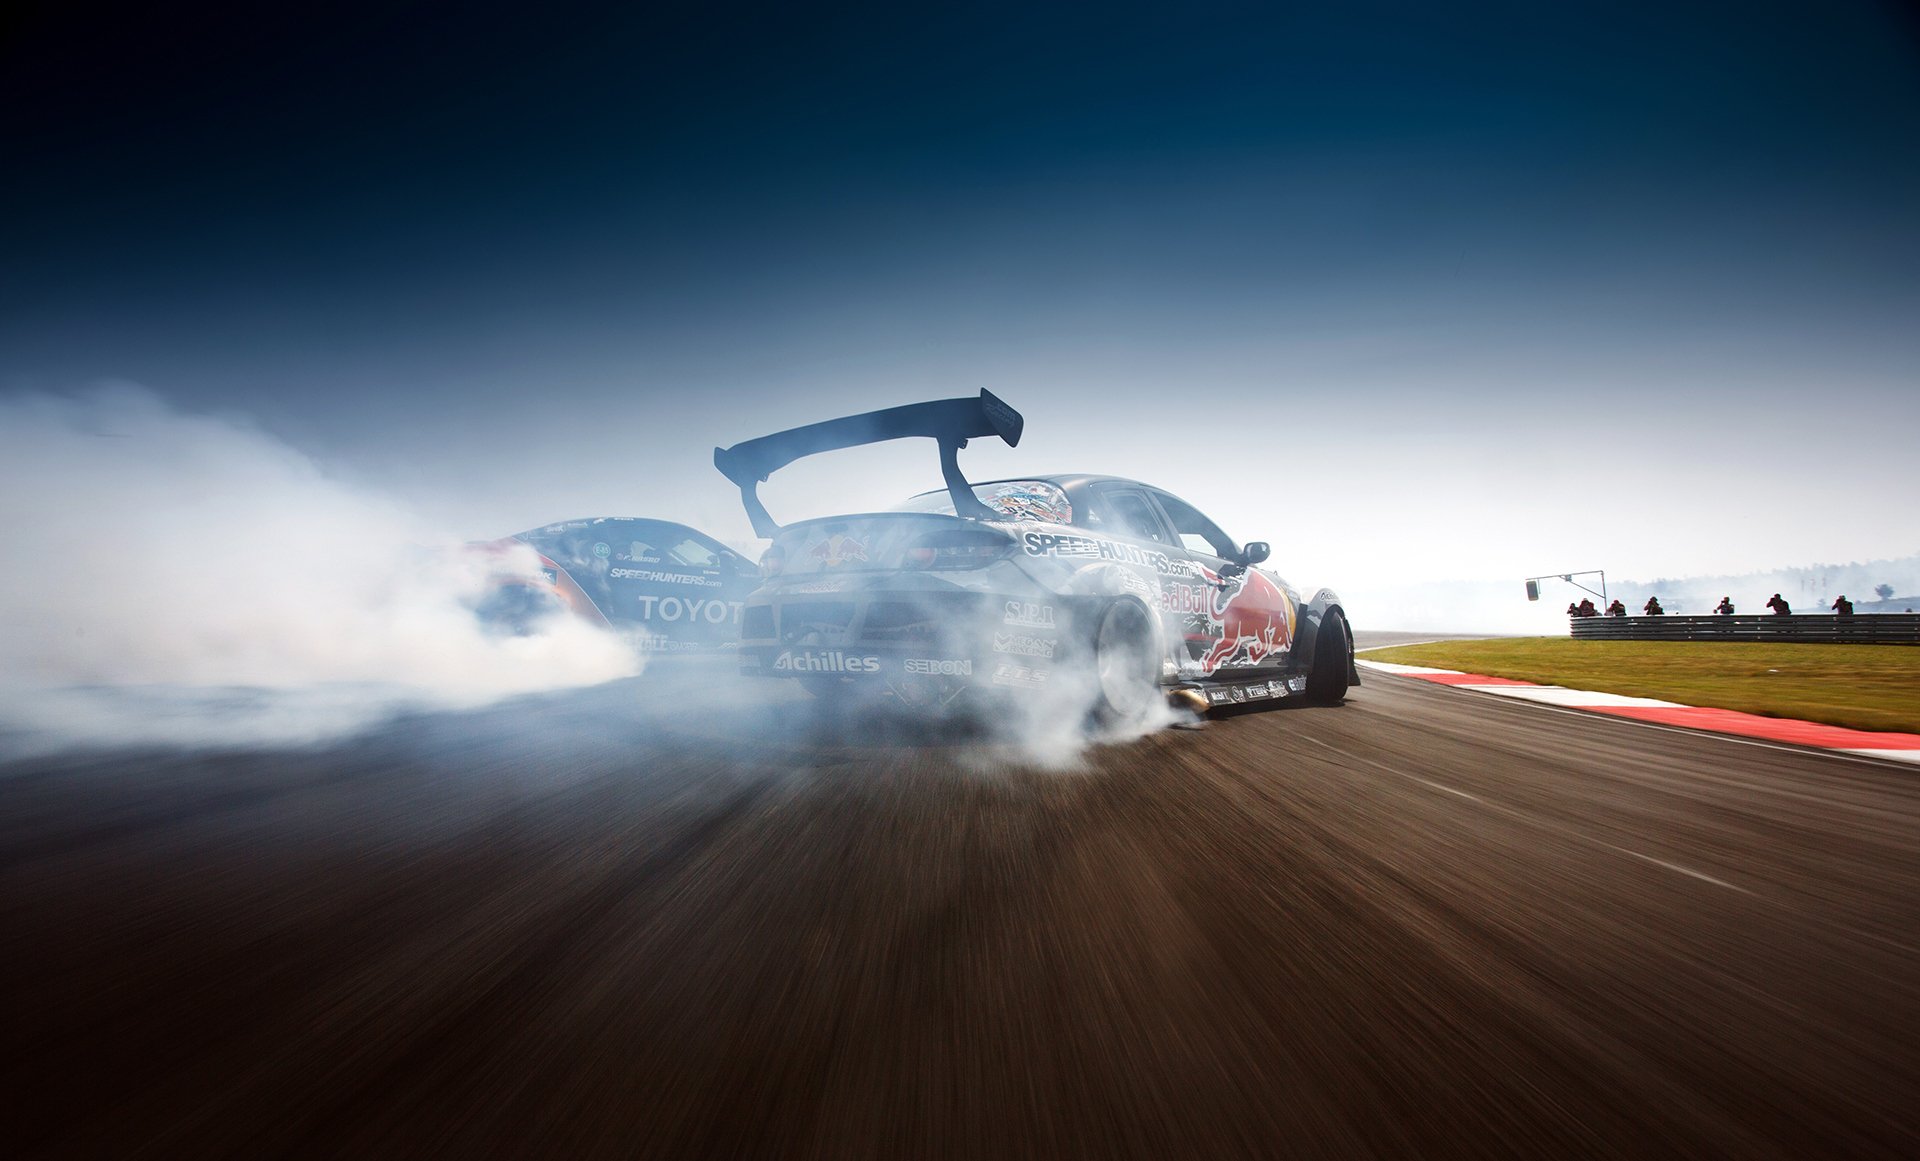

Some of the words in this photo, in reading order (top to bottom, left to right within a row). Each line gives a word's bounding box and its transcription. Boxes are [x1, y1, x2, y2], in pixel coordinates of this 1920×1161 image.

[610, 567, 722, 588] SPEEDHUNTERS.com
[638, 595, 745, 625] TOYOT
[1160, 582, 1180, 613] ed
[1181, 584, 1208, 614] Bull
[774, 651, 881, 672] Achilles
